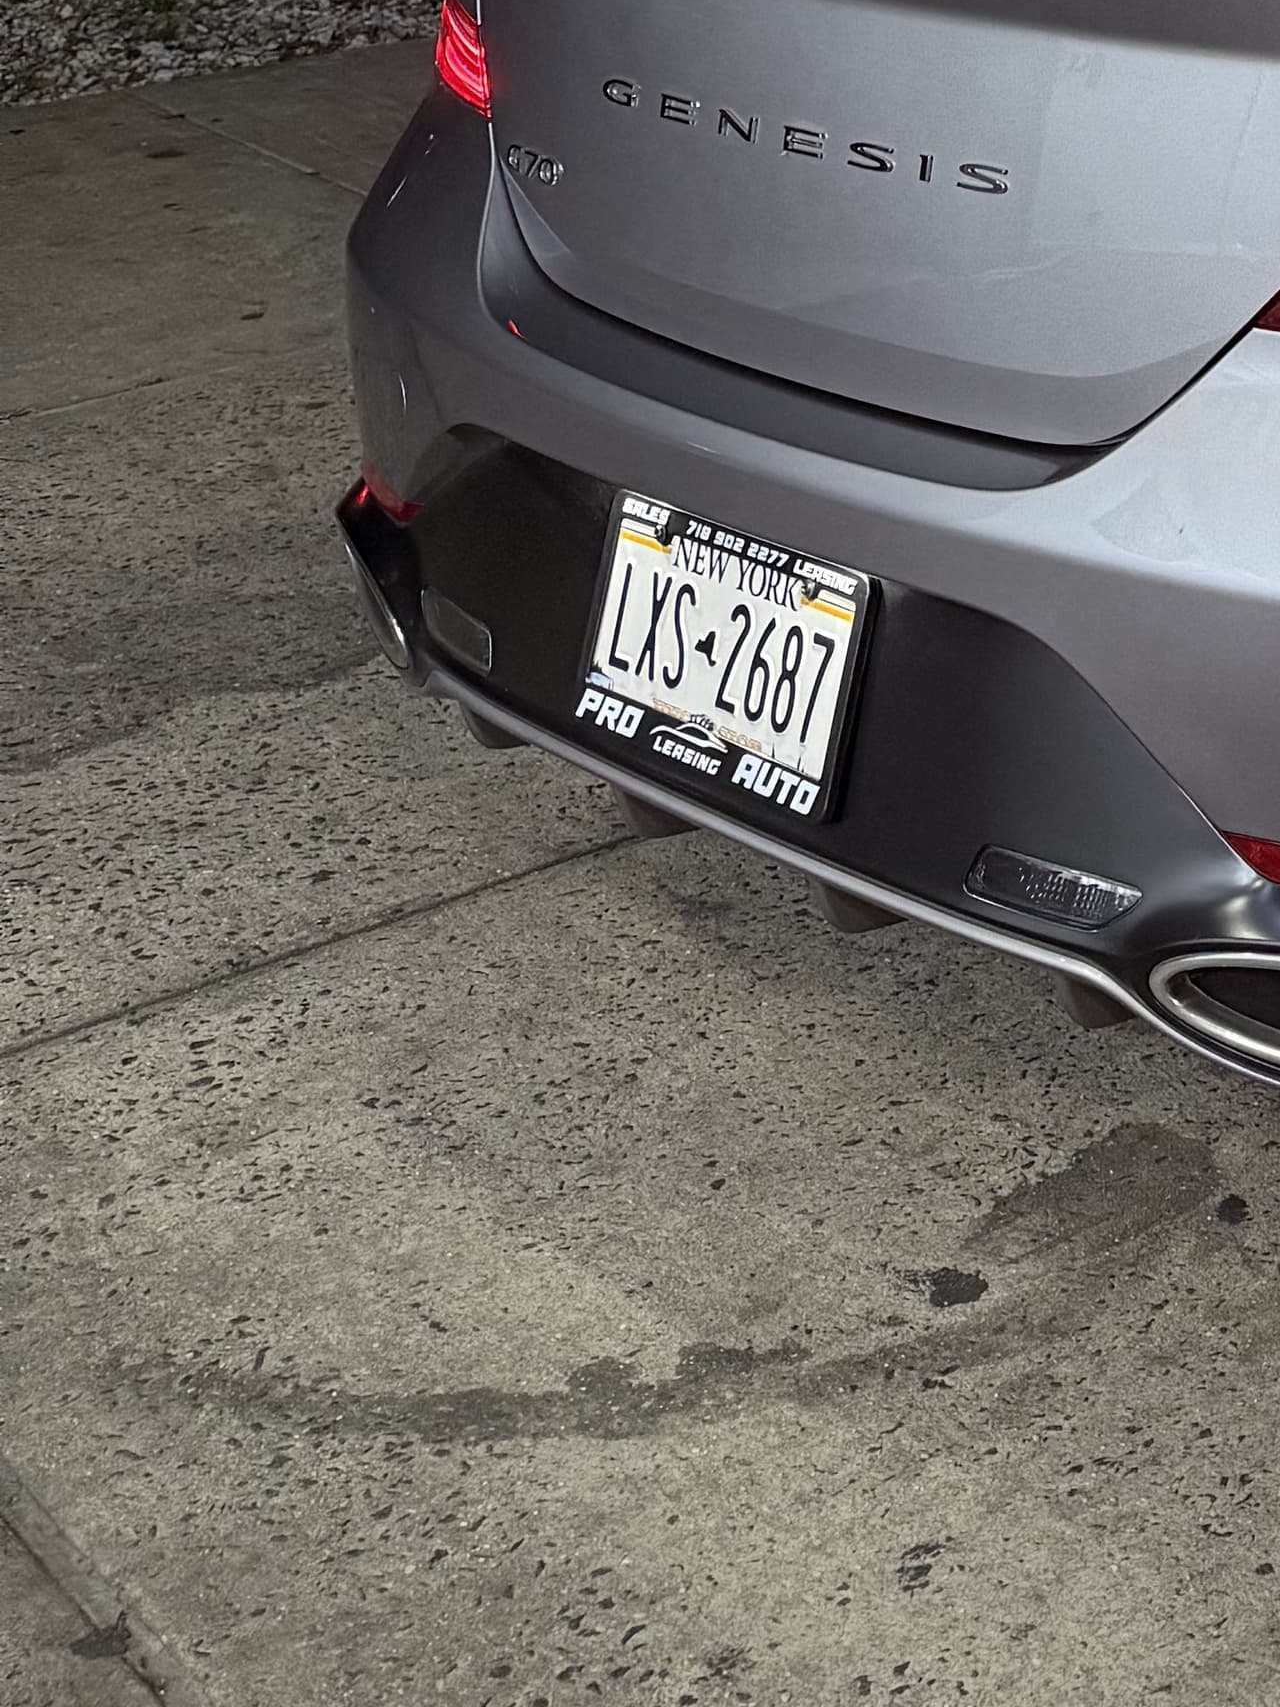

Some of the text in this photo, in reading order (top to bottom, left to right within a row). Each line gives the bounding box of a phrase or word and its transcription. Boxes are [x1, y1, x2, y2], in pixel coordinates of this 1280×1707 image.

[507, 143, 565, 186] G70
[602, 78, 1009, 194] GENESIS
[622, 497, 858, 596] SALES 718 902 2277 LEASING
[672, 537, 805, 612] NEW YORK
[609, 562, 835, 743] LXS 2687
[575, 687, 645, 739] PRO
[731, 753, 821, 815] AUTO
[652, 735, 722, 776] LEASING
